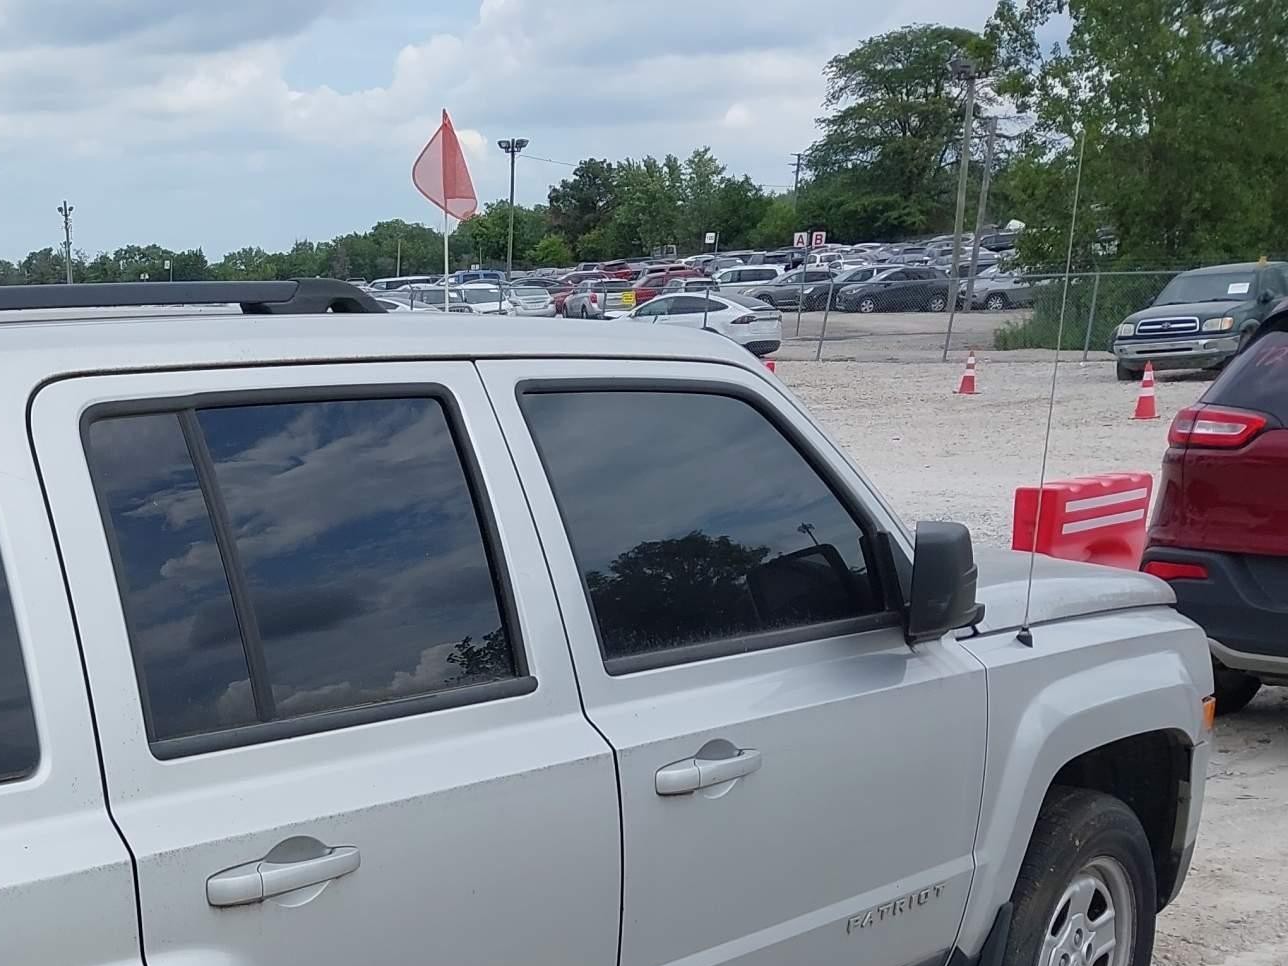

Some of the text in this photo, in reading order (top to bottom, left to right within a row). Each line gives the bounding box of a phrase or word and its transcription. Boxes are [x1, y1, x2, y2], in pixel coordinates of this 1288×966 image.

[796, 234, 805, 246] A
[814, 233, 824, 246] B
[846, 884, 945, 935] PATRIOT
